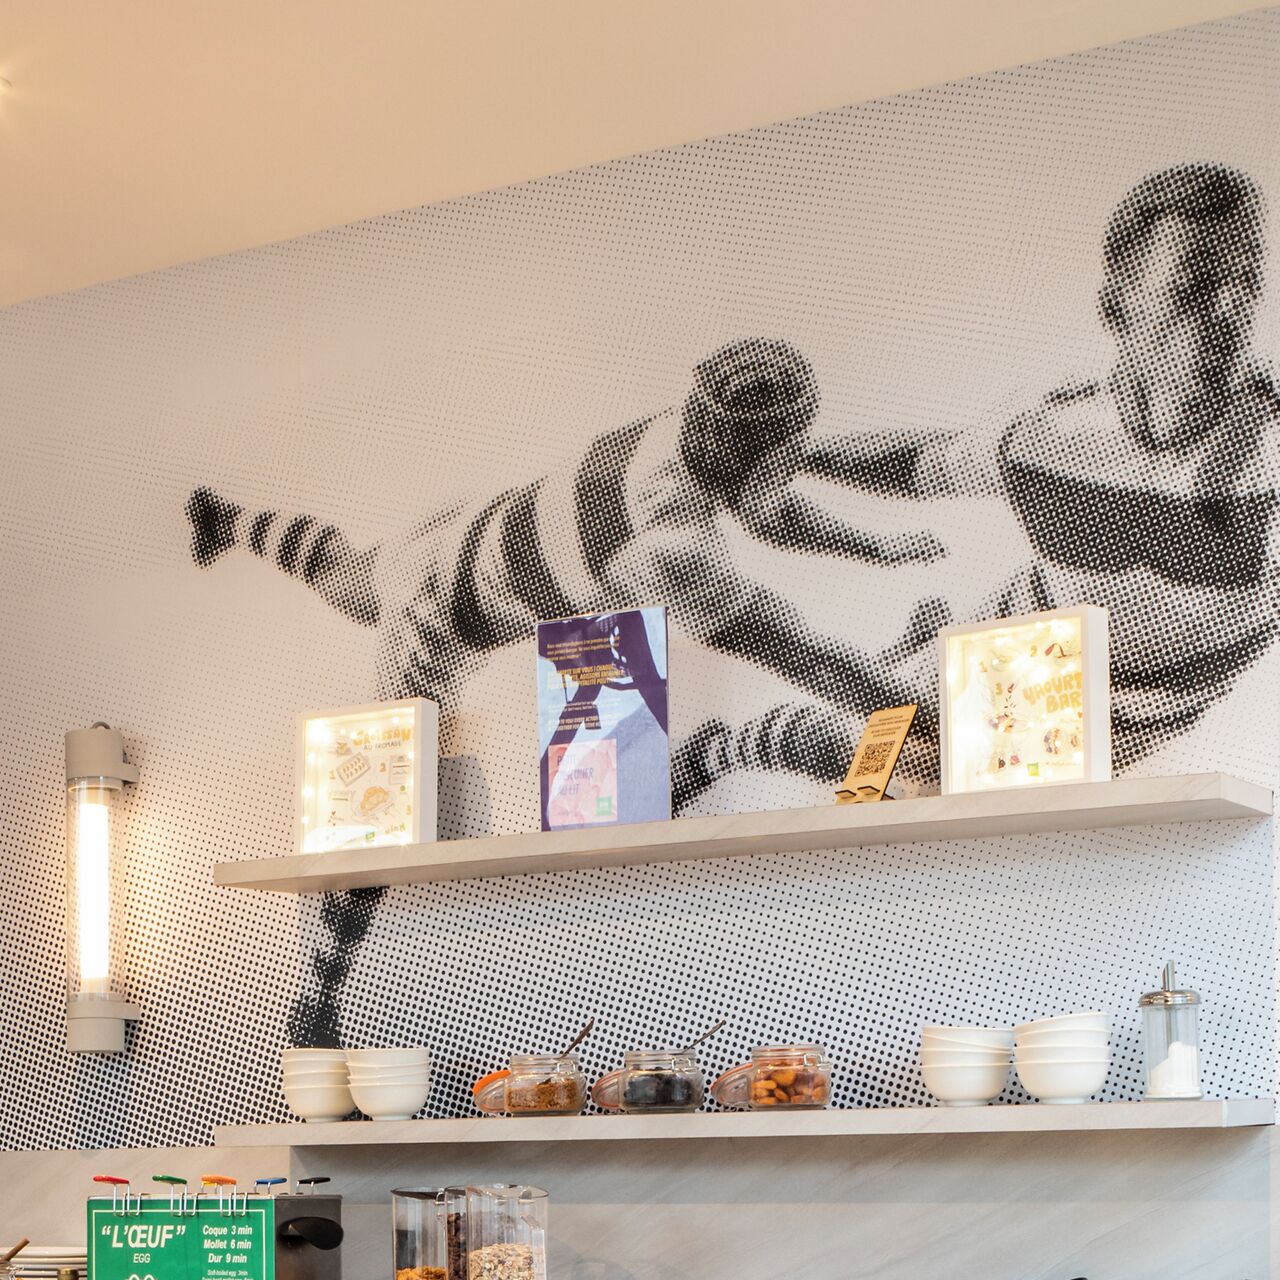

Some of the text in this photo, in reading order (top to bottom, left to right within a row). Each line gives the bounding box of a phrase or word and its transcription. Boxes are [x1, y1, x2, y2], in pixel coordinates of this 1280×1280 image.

[202, 1225, 253, 1237] Coque 3 min
[203, 1239, 252, 1249] Mollet 6 min
[133, 1253, 151, 1264] EGG
[208, 1253, 248, 1263] Dur 9 min
